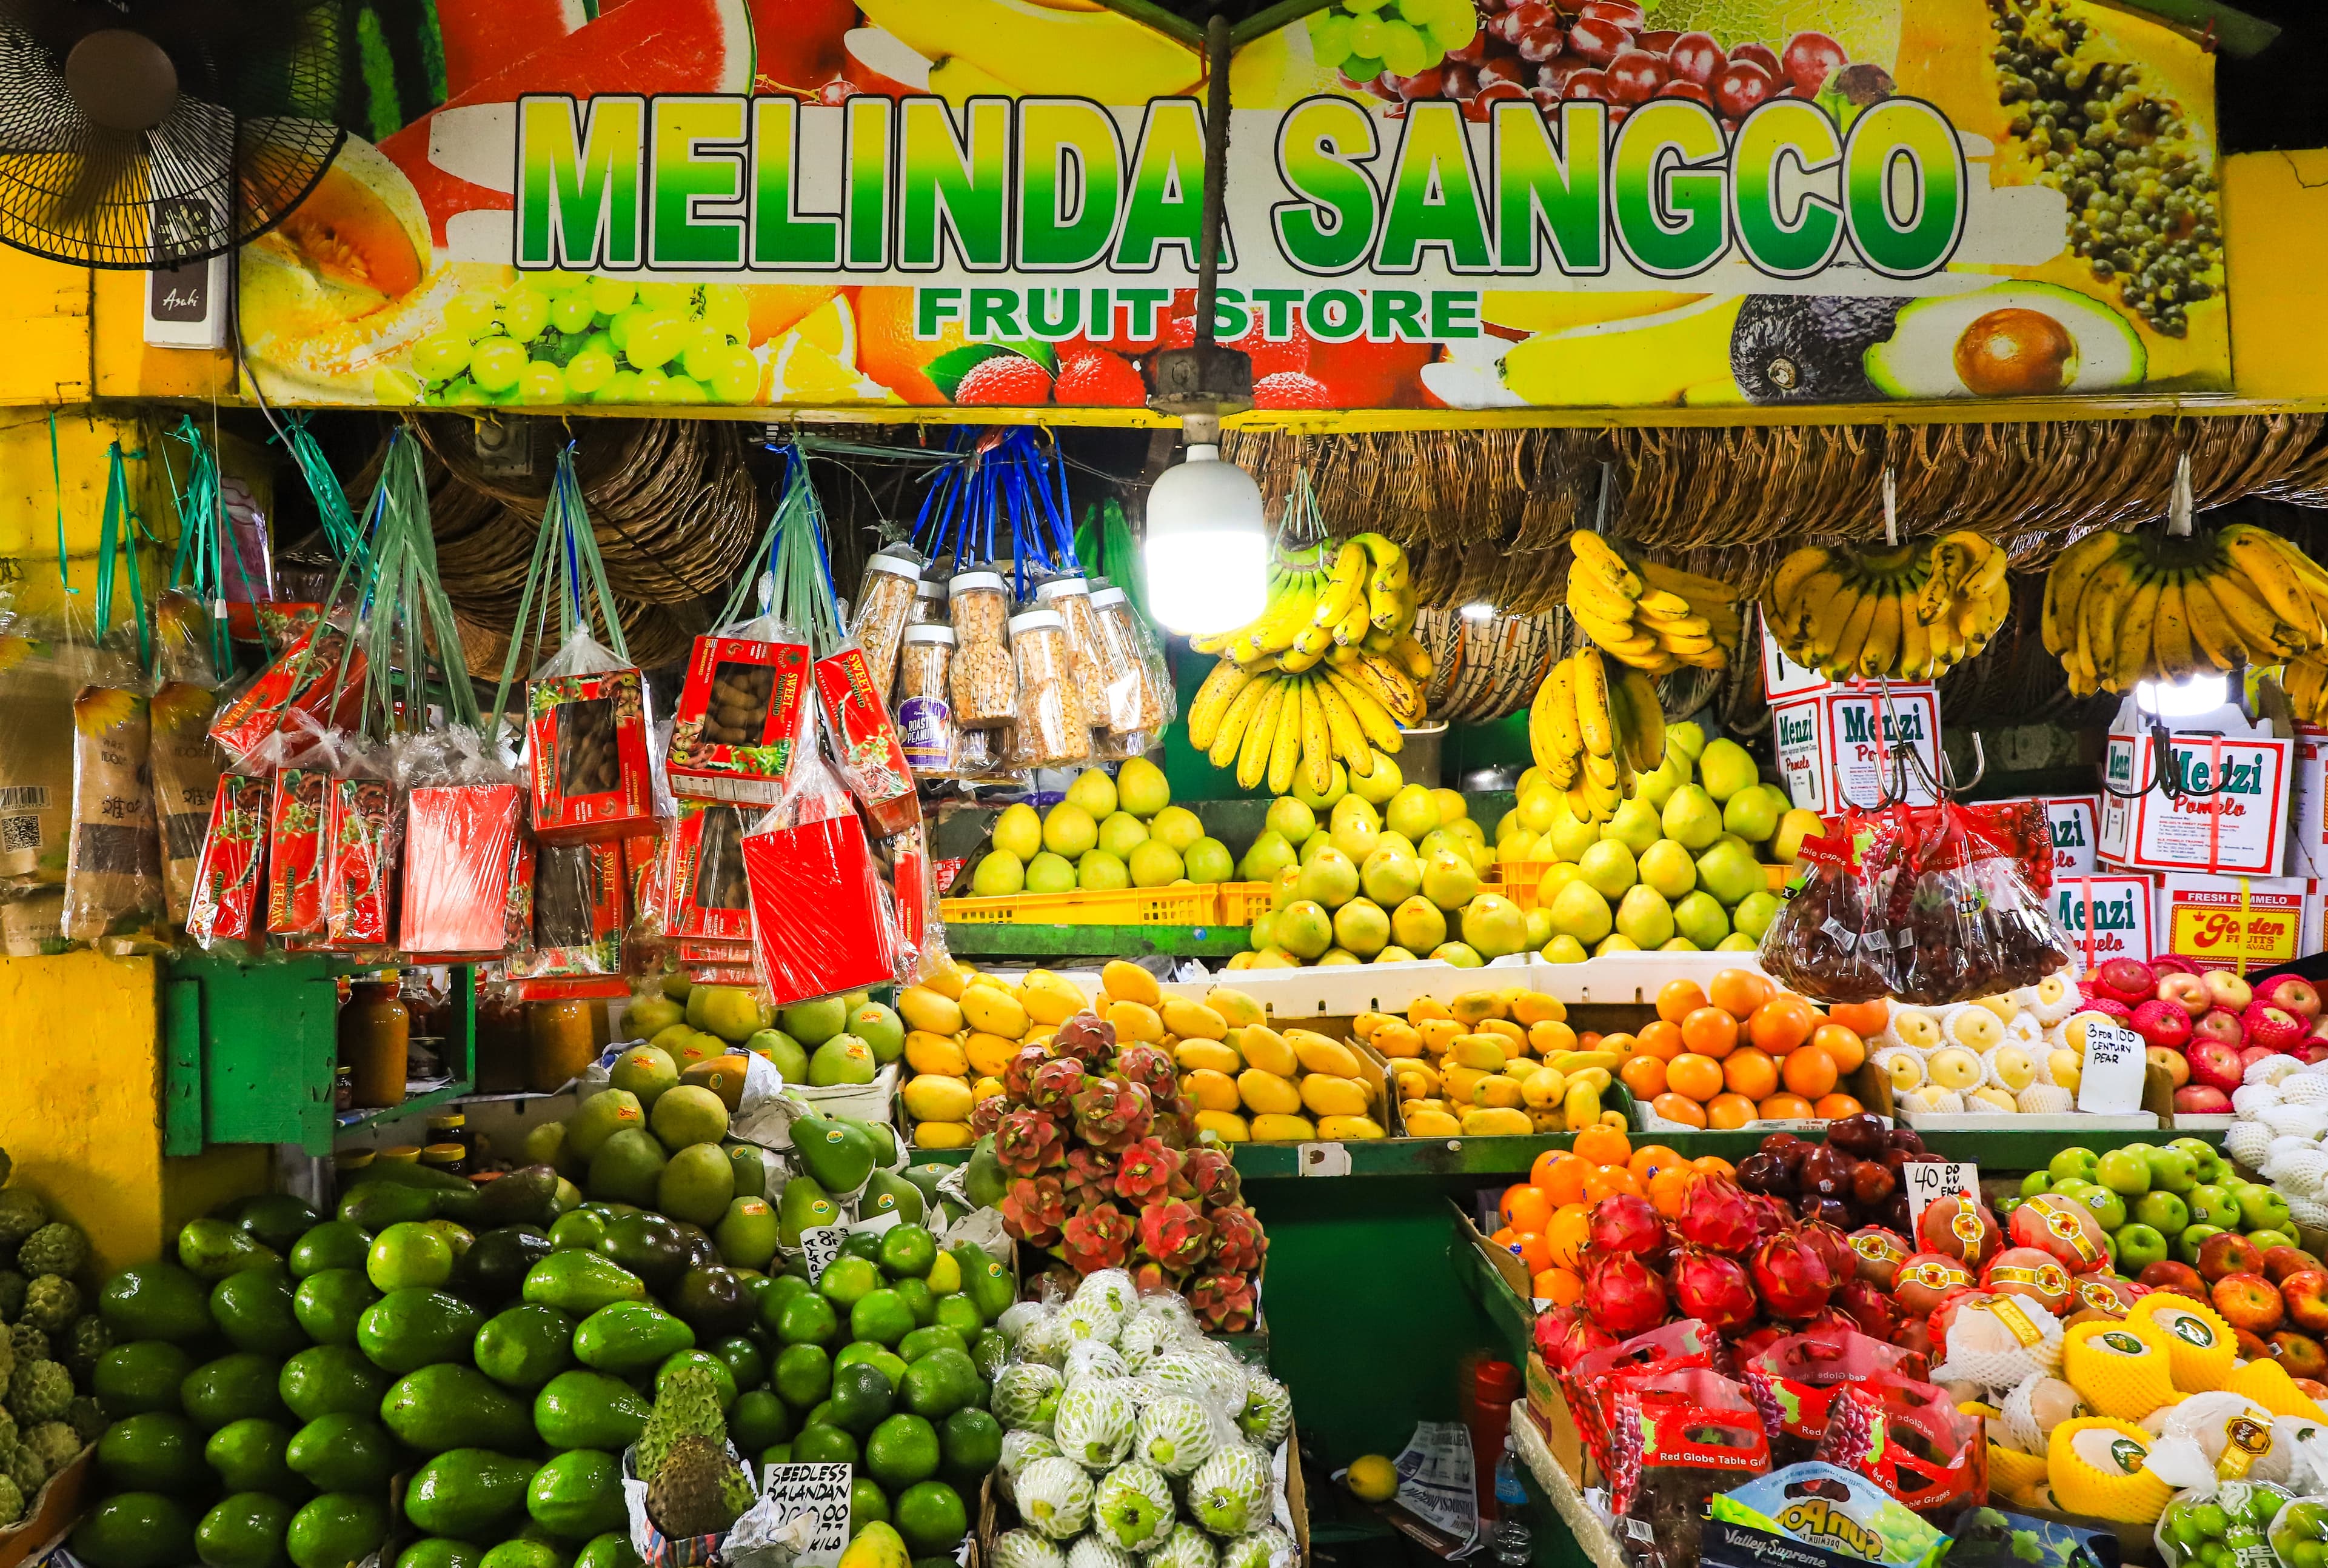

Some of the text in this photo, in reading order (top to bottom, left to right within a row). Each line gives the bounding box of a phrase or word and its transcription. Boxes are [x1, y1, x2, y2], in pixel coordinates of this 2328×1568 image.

[514, 92, 1968, 280] MELINDA SANGCO
[162, 287, 199, 311] Asahi
[917, 286, 1481, 339] FRUIT STORE
[777, 647, 791, 669] NATCHA
[841, 659, 866, 709] TAMARIND
[848, 653, 873, 693] SWEET
[772, 673, 787, 716] TAMARIND
[783, 672, 798, 709] SWEET
[816, 668, 840, 722] PREMIUM QUALITY
[1779, 709, 1814, 747] Menzi
[1842, 703, 1924, 743] Menzi
[1785, 755, 1810, 772] Pomelo
[2050, 809, 2086, 848] nzi
[1799, 846, 1847, 867] able Gapes
[604, 851, 615, 892] SWEET
[674, 856, 688, 900] SWEET
[685, 844, 697, 898] TAMARIND
[271, 879, 286, 927] SWEET
[2059, 888, 2135, 930] Menzi
[2187, 893, 2288, 905] FRESH PUMMELO
[2069, 932, 2125, 951] omelo
[2193, 913, 2285, 948] Goden
[2087, 1023, 2135, 1043] 3 FOR 100
[2092, 1041, 2131, 1053] CENTURY
[2093, 1052, 2119, 1065] PEAR
[1915, 1165, 1939, 1193] 40
[1941, 1185, 1965, 1196] EACH
[839, 1227, 850, 1238] ILO
[803, 1238, 823, 1284] APAYA
[1801, 1425, 1822, 1436] Red
[1660, 1452, 1680, 1462] Red
[1683, 1452, 1715, 1464] Globe
[1718, 1455, 1747, 1466] Table
[773, 1464, 848, 1487] SEEDLESS
[1871, 1467, 1884, 1483] Red
[766, 1483, 851, 1503] DALANDAN
[1923, 1489, 1950, 1505] Grapes
[808, 1536, 841, 1553] KILO
[1725, 1527, 1827, 1568] Valley Supreme
